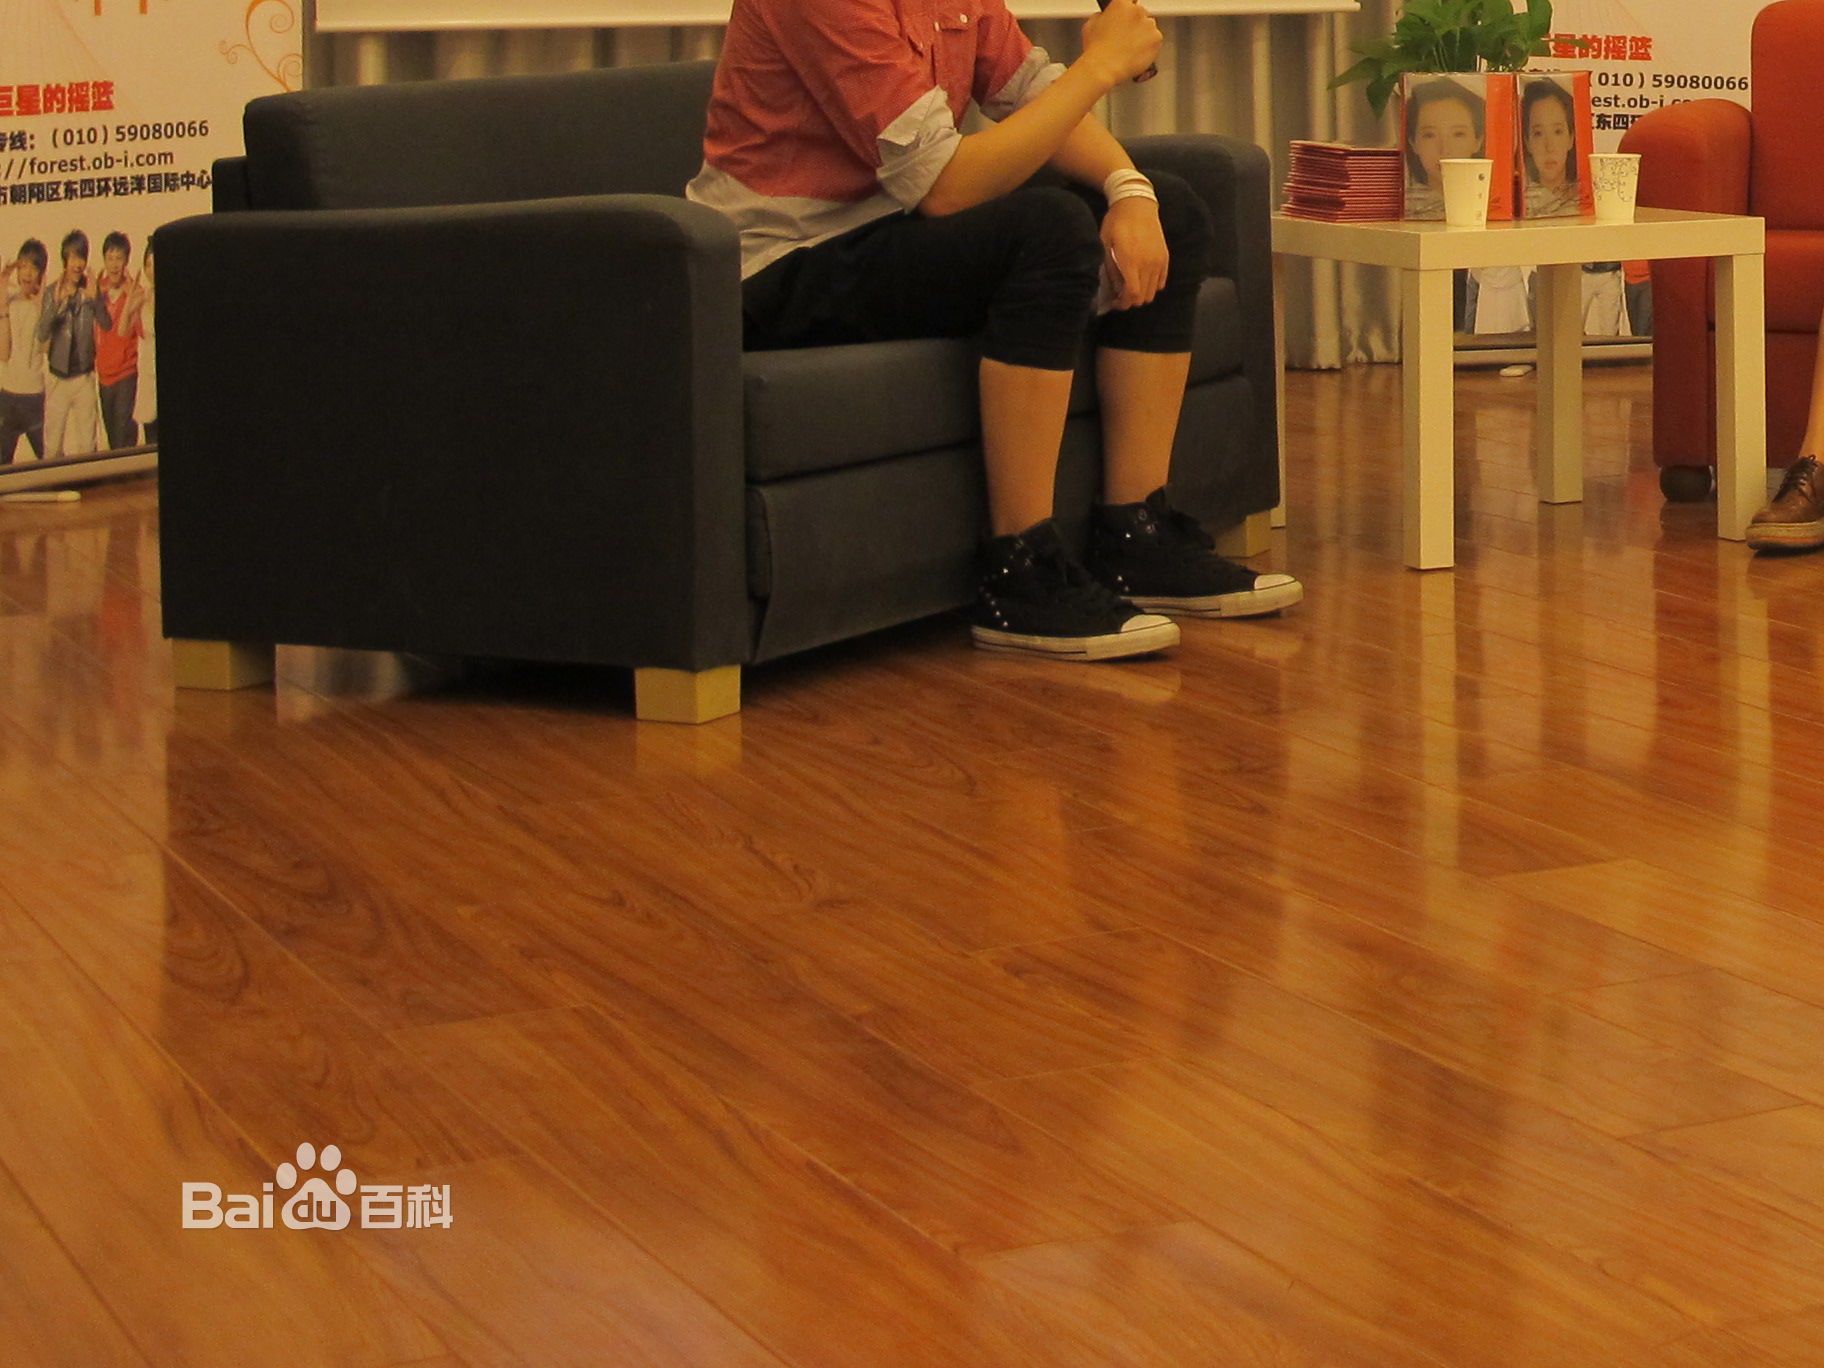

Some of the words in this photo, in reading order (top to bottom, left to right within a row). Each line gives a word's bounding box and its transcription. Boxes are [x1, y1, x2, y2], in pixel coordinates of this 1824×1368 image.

[1542, 33, 1652, 61] 星的摇篮
[1652, 74, 1749, 91] 59080066
[115, 120, 209, 142] 59080066
[0, 151, 174, 180] //forest.ob-i.com
